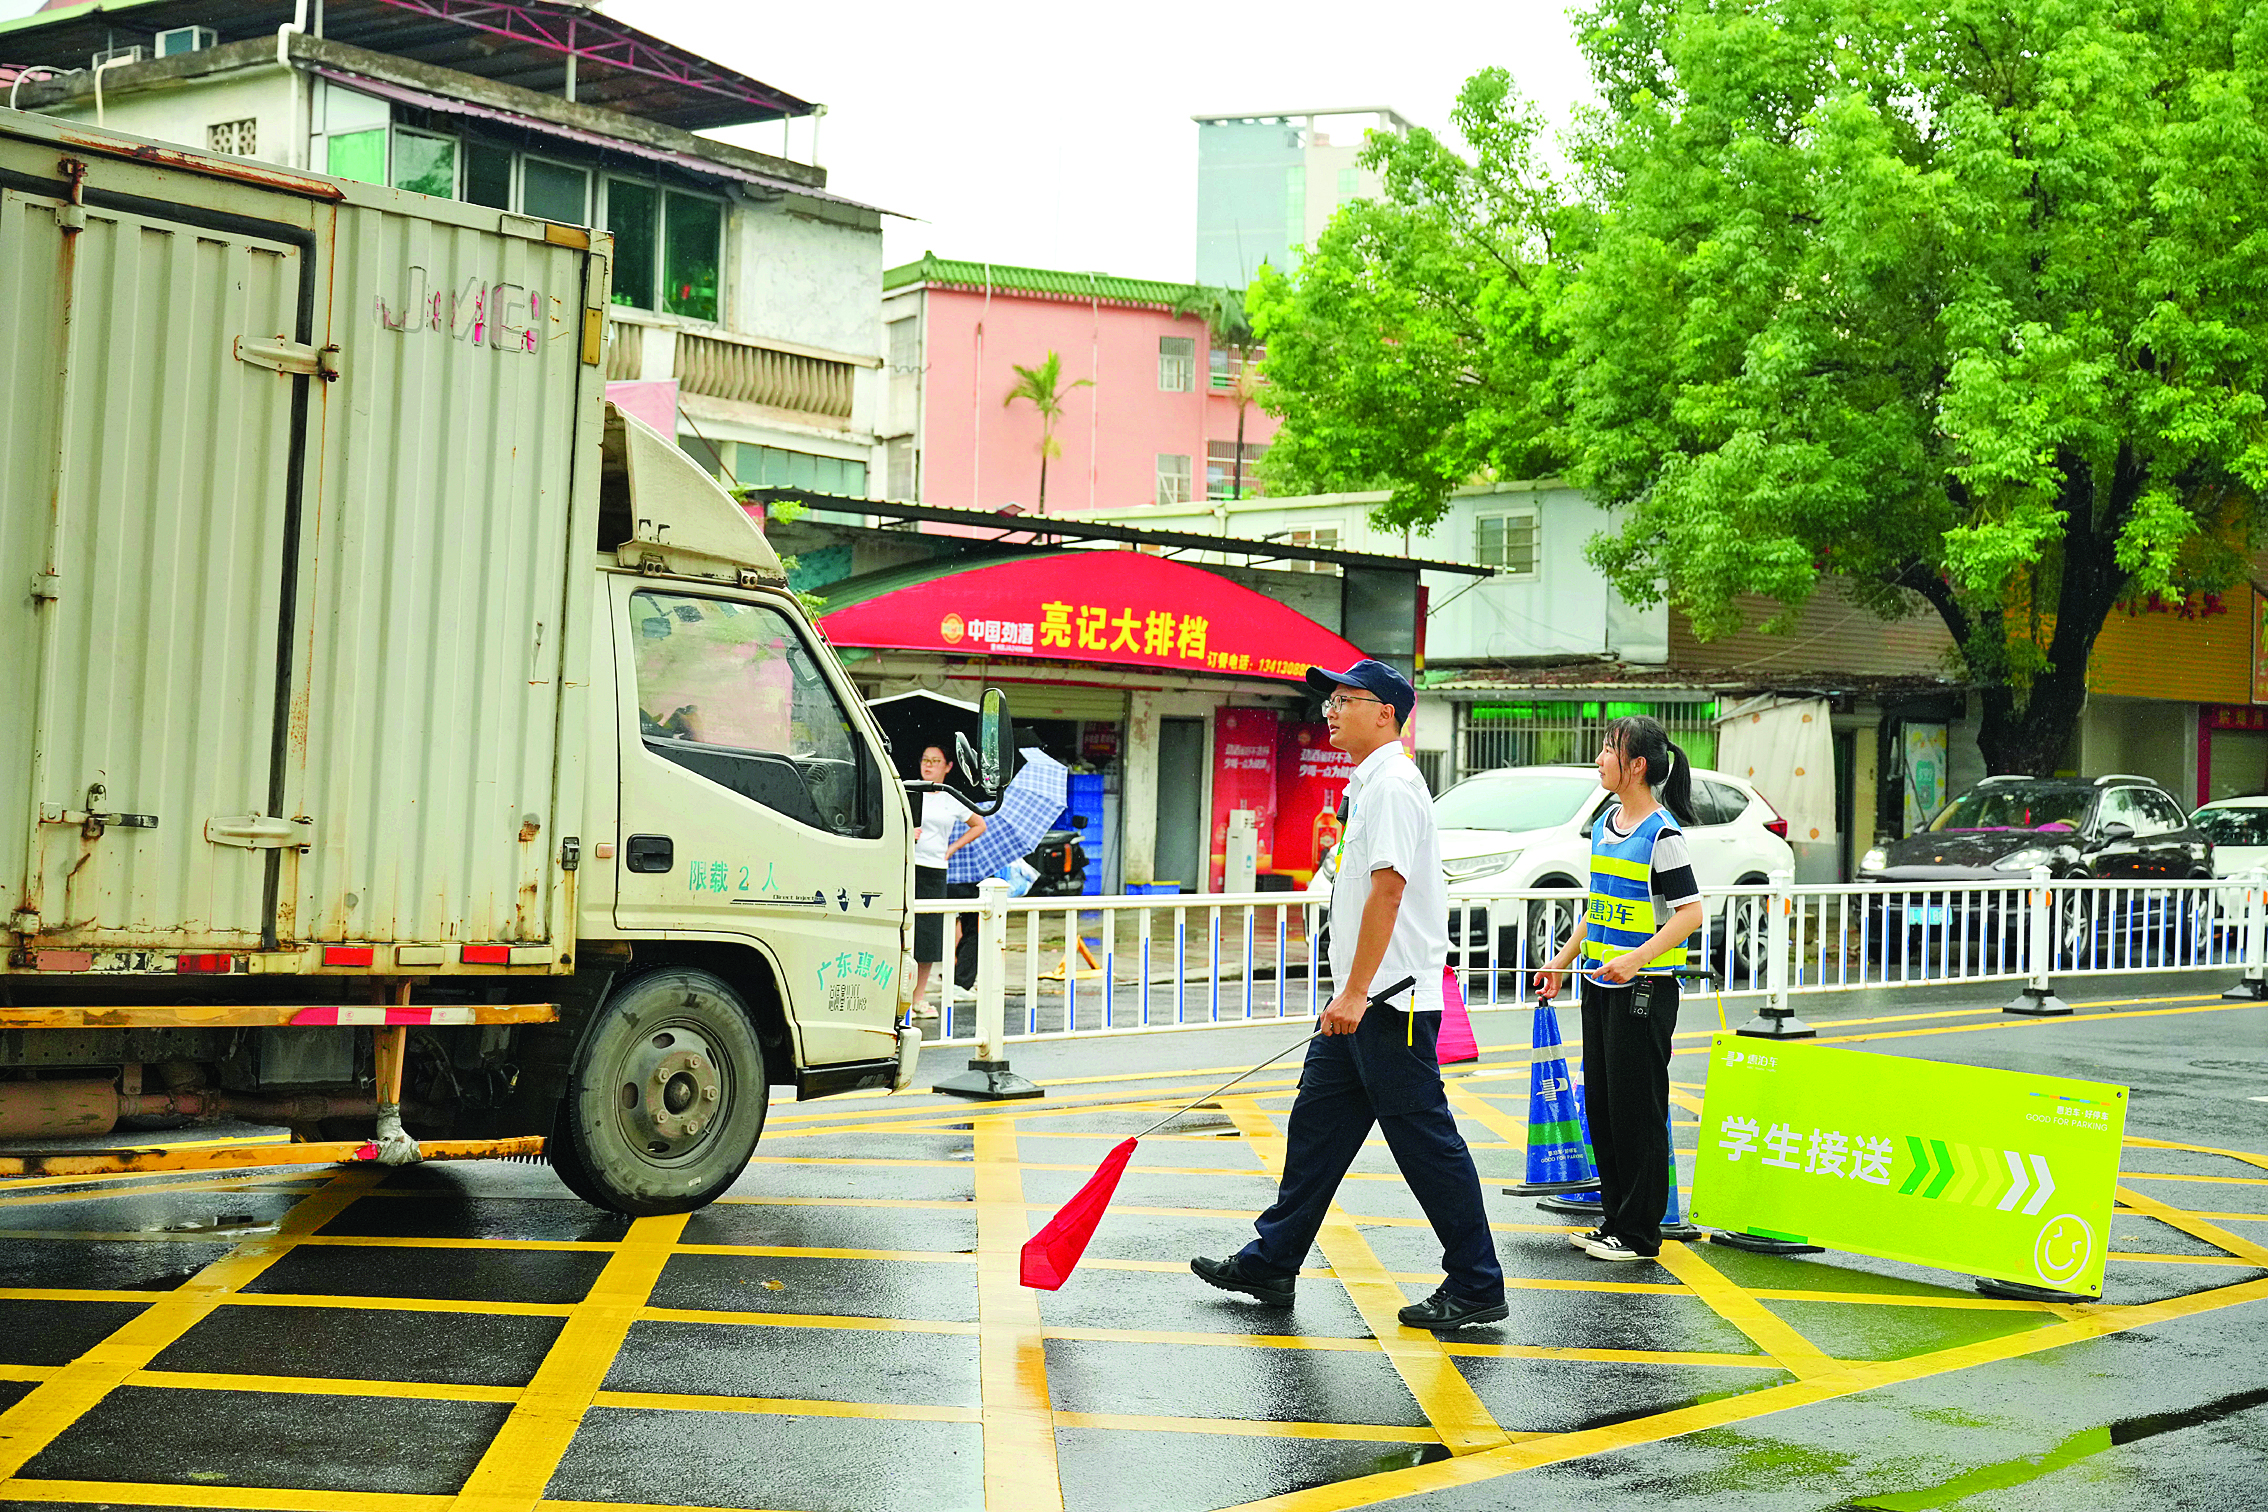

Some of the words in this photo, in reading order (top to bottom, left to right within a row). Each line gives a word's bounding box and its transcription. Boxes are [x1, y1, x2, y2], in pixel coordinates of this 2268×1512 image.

[967, 618, 1035, 645] 中国劲酒
[1039, 600, 1209, 660] 亮记大排档
[1257, 658, 1324, 677] 13413088
[816, 951, 894, 991] 广东惠州
[1746, 1053, 1779, 1068] 惠泊车
[2025, 1113, 2052, 1123] GOOD
[2053, 1116, 2070, 1126] FOR
[2071, 1119, 2108, 1132] PARKING
[1718, 1115, 1893, 1186] 学生接送
